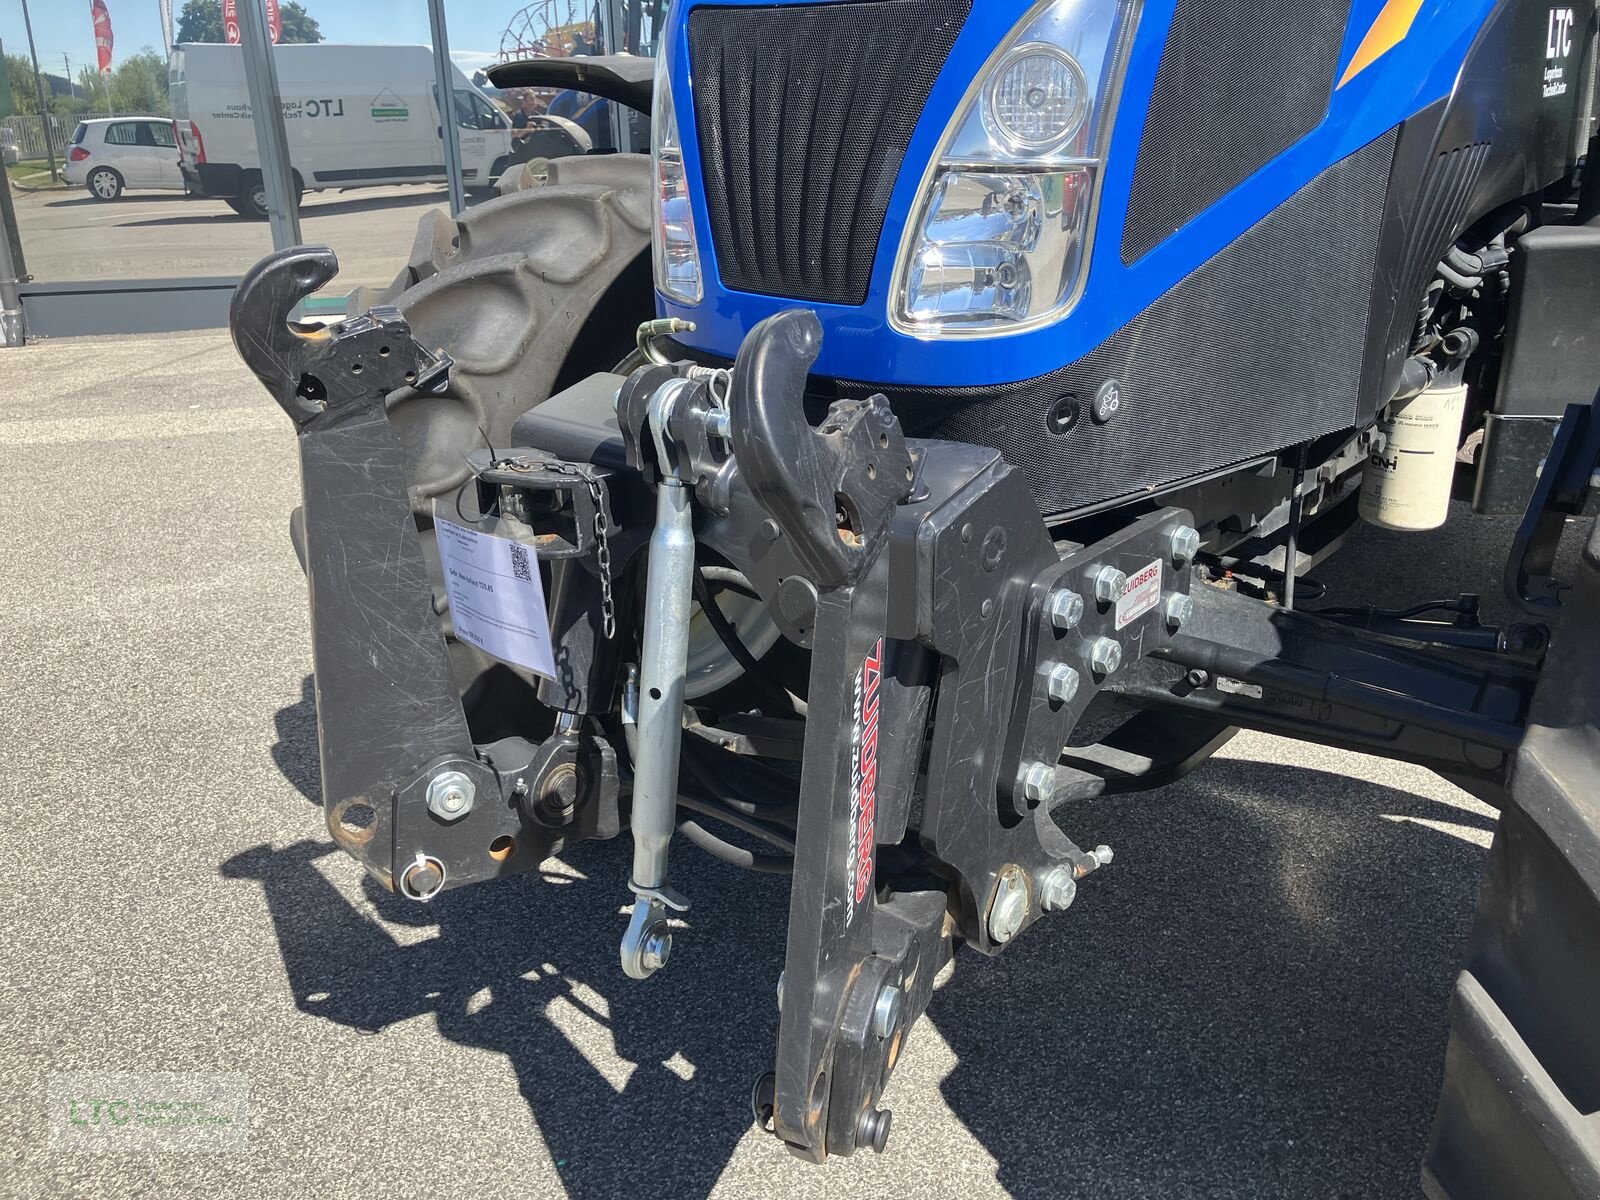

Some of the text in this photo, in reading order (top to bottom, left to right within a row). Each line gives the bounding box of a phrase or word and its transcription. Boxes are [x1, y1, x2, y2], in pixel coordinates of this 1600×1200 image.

[1546, 8, 1573, 59] LTC
[846, 667, 862, 929] www.zuidberg.com
[855, 637, 882, 904] ZUIDBERG
